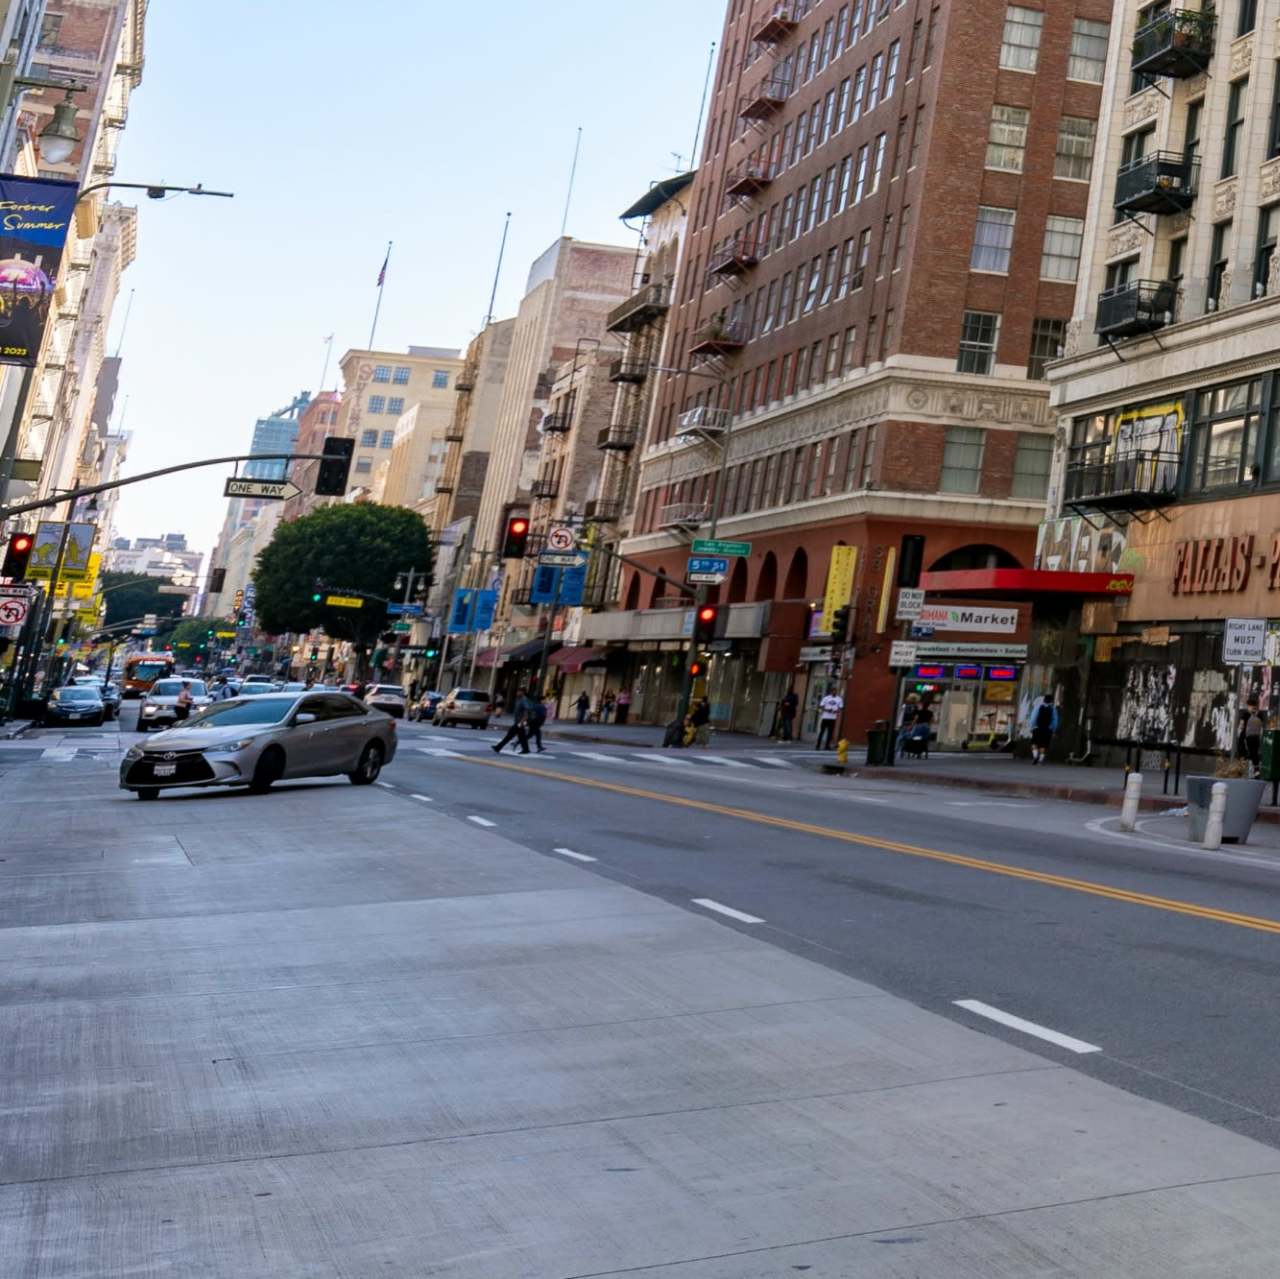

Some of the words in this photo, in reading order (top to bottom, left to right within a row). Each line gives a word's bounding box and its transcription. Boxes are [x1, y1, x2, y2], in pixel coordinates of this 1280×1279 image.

[4, 214, 65, 231] Summer
[230, 483, 254, 493] ONE
[260, 485, 285, 494] WAY
[1172, 535, 1254, 596] FALLAS
[960, 611, 1017, 625] Market
[1234, 635, 1256, 644] MUST
